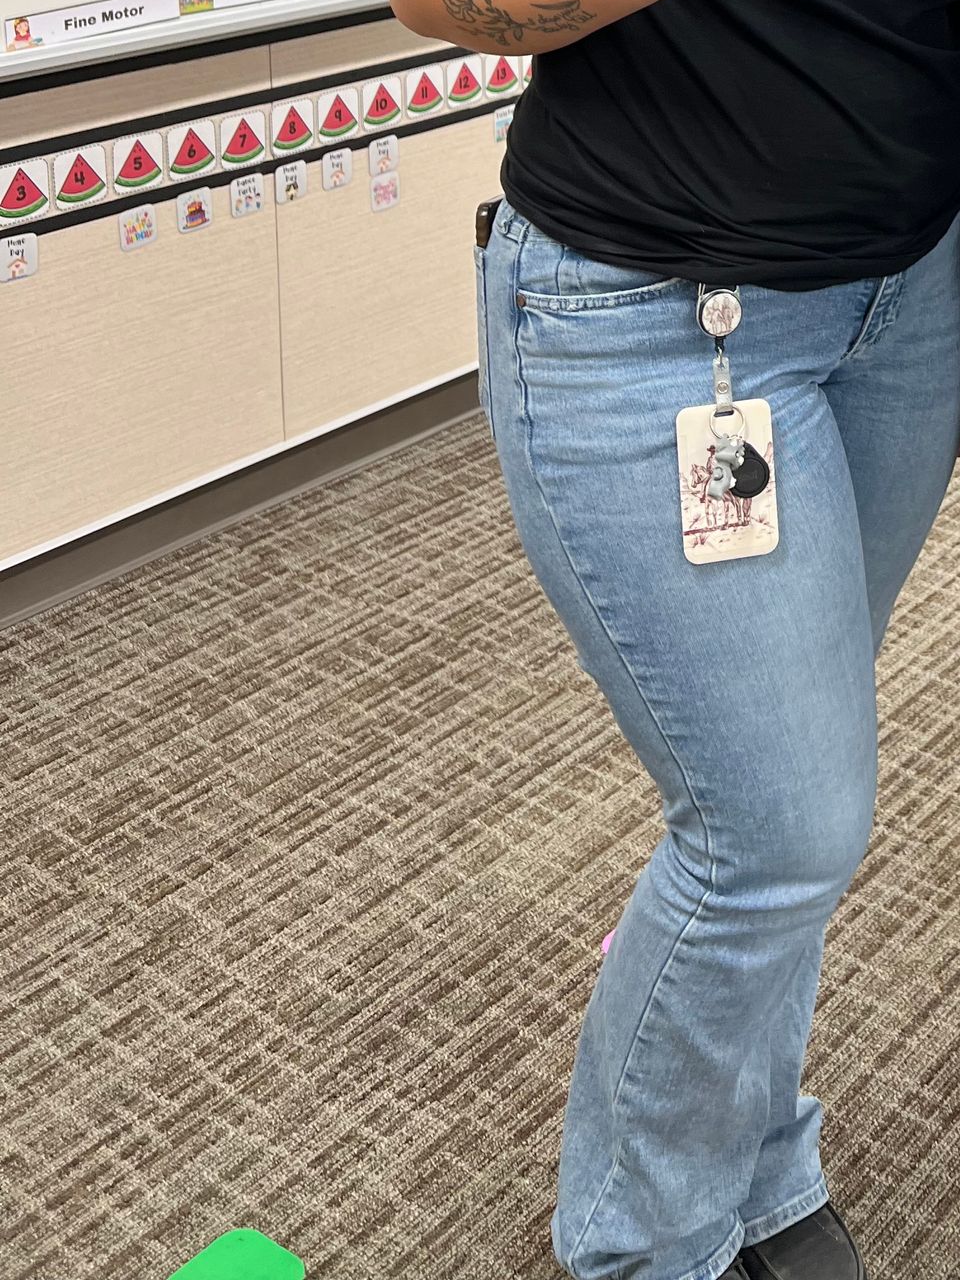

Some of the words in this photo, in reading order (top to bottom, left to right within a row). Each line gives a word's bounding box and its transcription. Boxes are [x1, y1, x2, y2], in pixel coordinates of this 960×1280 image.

[63, 12, 97, 31] Fine
[101, 4, 145, 23] Motor
[16, 185, 27, 202] 3
[74, 171, 86, 186] 4
[133, 156, 144, 171] 5
[187, 144, 197, 159] 6
[239, 133, 247, 148] 7
[288, 121, 297, 135] 8
[335, 108, 342, 121] 9
[375, 98, 388, 111] 10
[421, 86, 428, 99] 11
[459, 76, 470, 89] 12
[496, 67, 507, 80] 13
